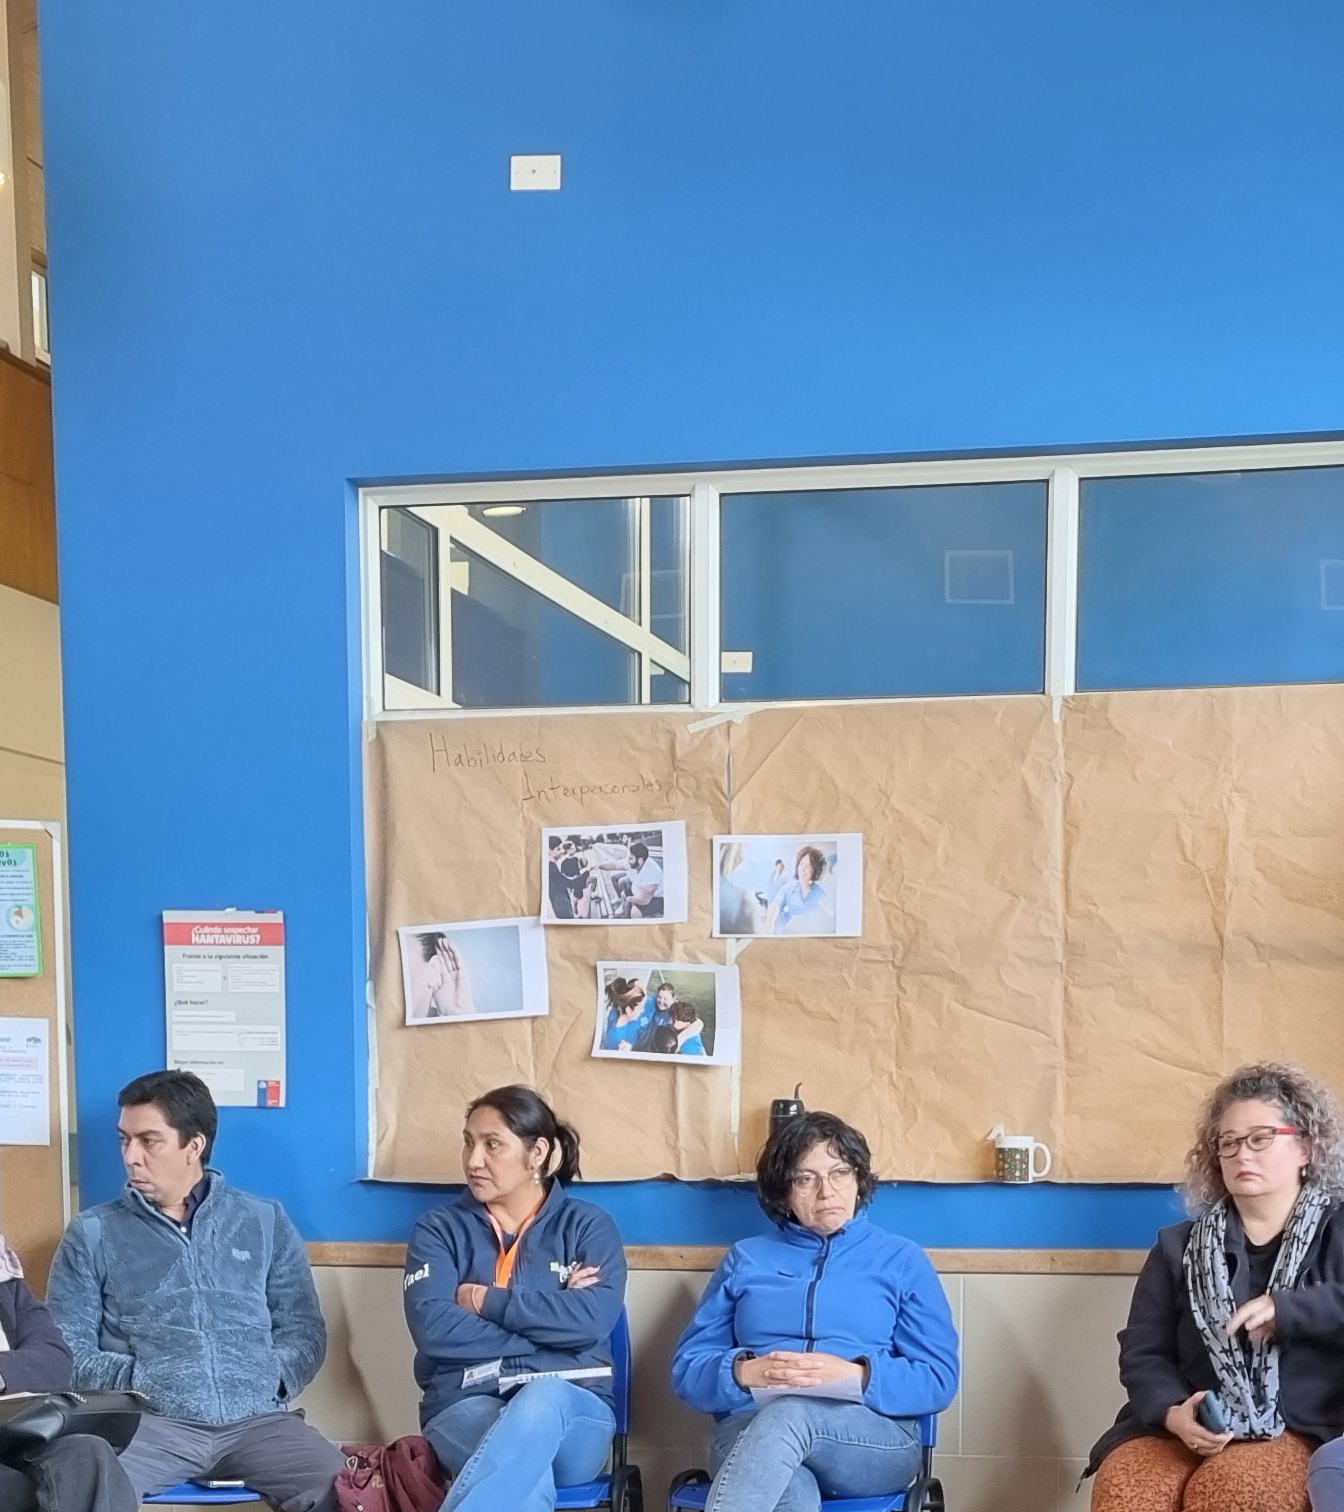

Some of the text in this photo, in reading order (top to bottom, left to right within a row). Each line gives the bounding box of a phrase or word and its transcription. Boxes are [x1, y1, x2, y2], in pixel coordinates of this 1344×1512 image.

[522, 771, 664, 807] Interpersonales
[223, 926, 259, 935] sospechar
[191, 934, 261, 945] HANTAVIRUS?
